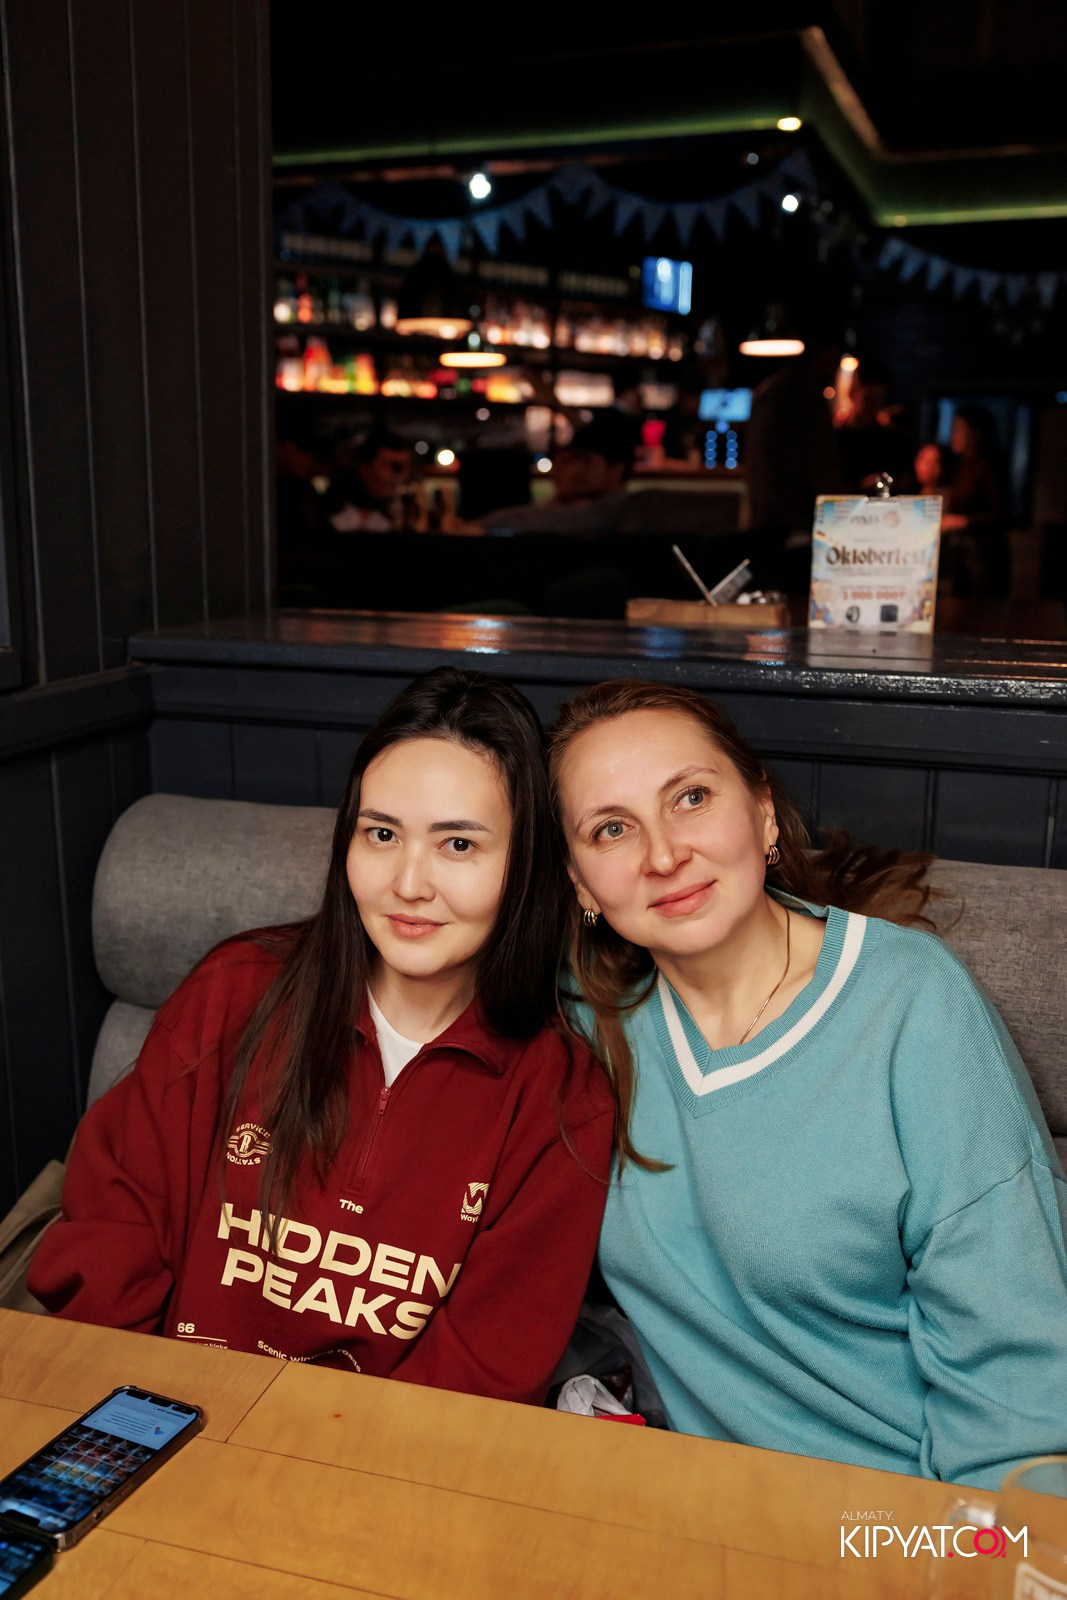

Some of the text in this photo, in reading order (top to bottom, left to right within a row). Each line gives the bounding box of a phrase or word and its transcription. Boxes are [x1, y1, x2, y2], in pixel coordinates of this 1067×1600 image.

[339, 1198, 364, 1215] The
[217, 1202, 462, 1298] HIDDEN
[220, 1247, 434, 1340] PEAKS
[177, 1322, 195, 1334] 66
